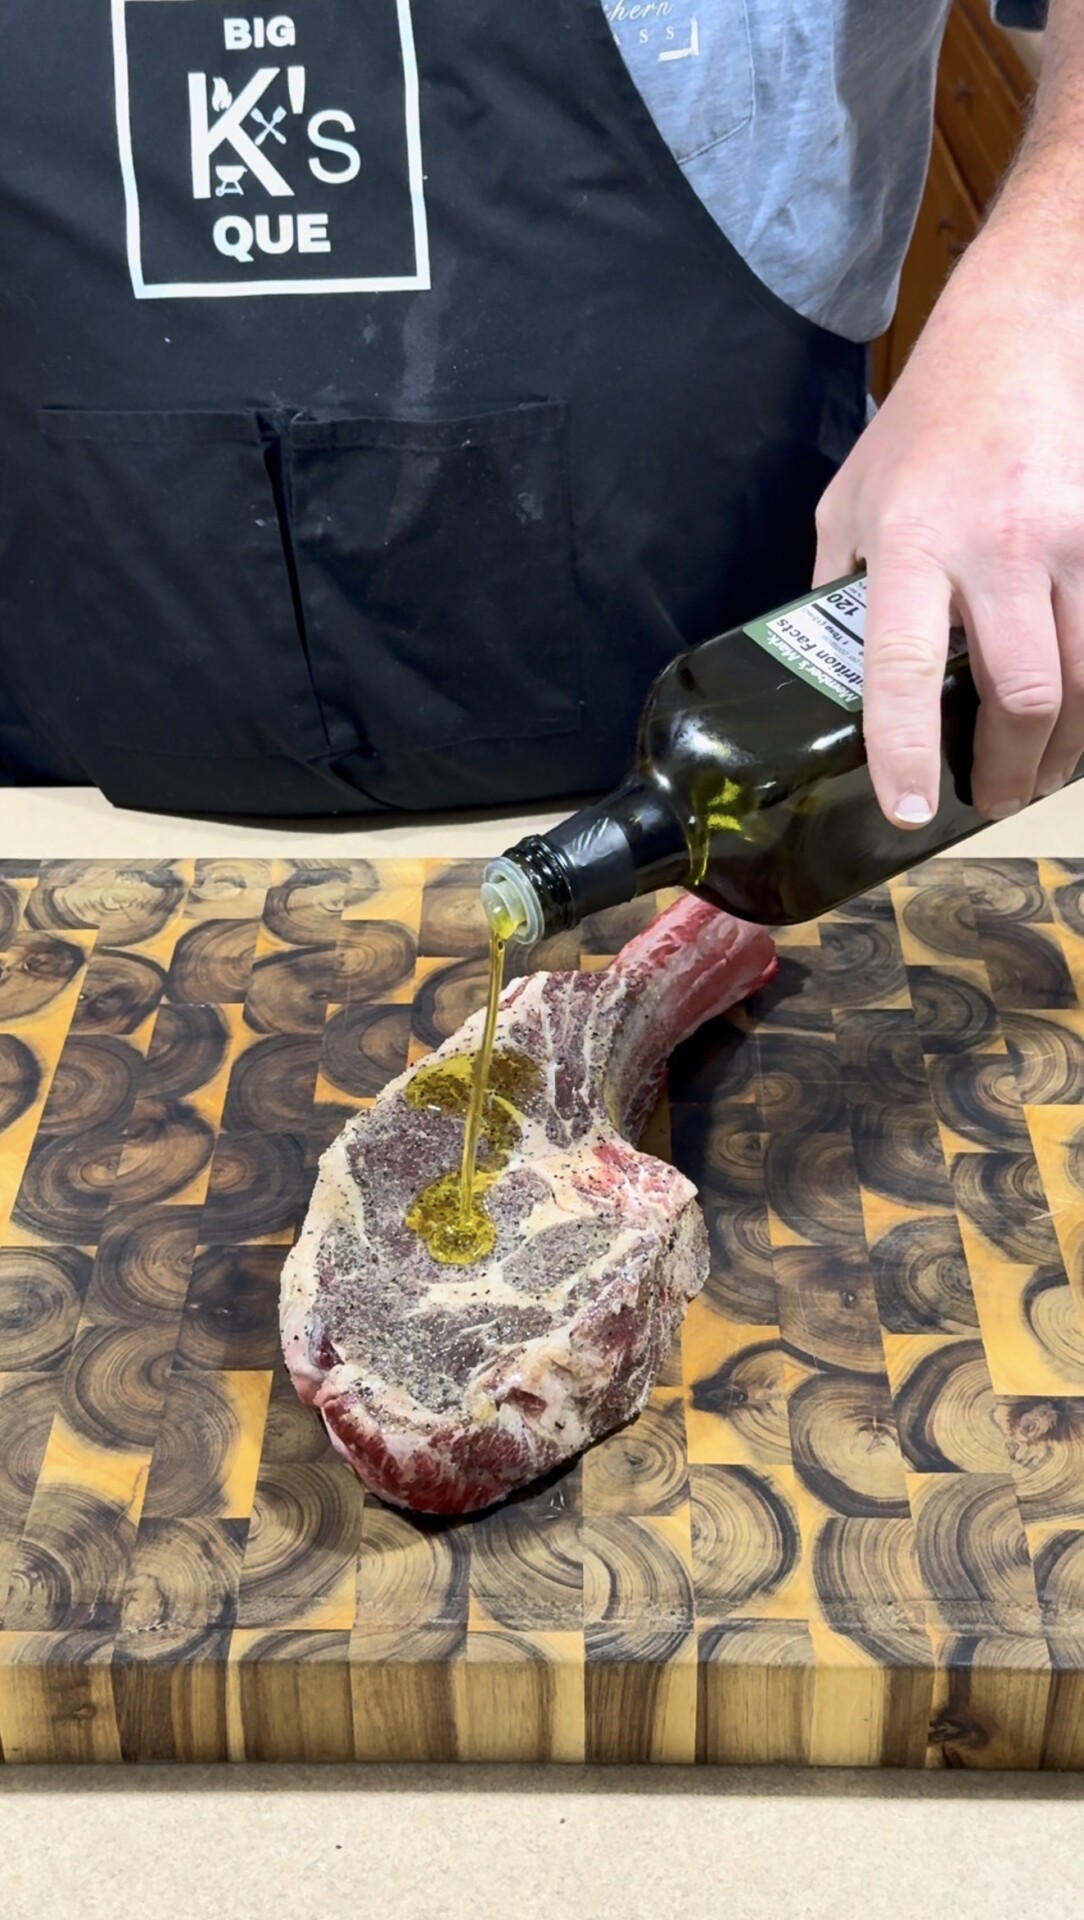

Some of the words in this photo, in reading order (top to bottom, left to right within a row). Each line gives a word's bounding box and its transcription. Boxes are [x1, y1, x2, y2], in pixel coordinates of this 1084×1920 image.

[223, 15, 296, 50] BIG
[212, 213, 331, 263] QUE
[826, 593, 860, 617] 120
[776, 618, 817, 652] Facts
[798, 659, 859, 703] Member's
[815, 650, 863, 686] utrition
